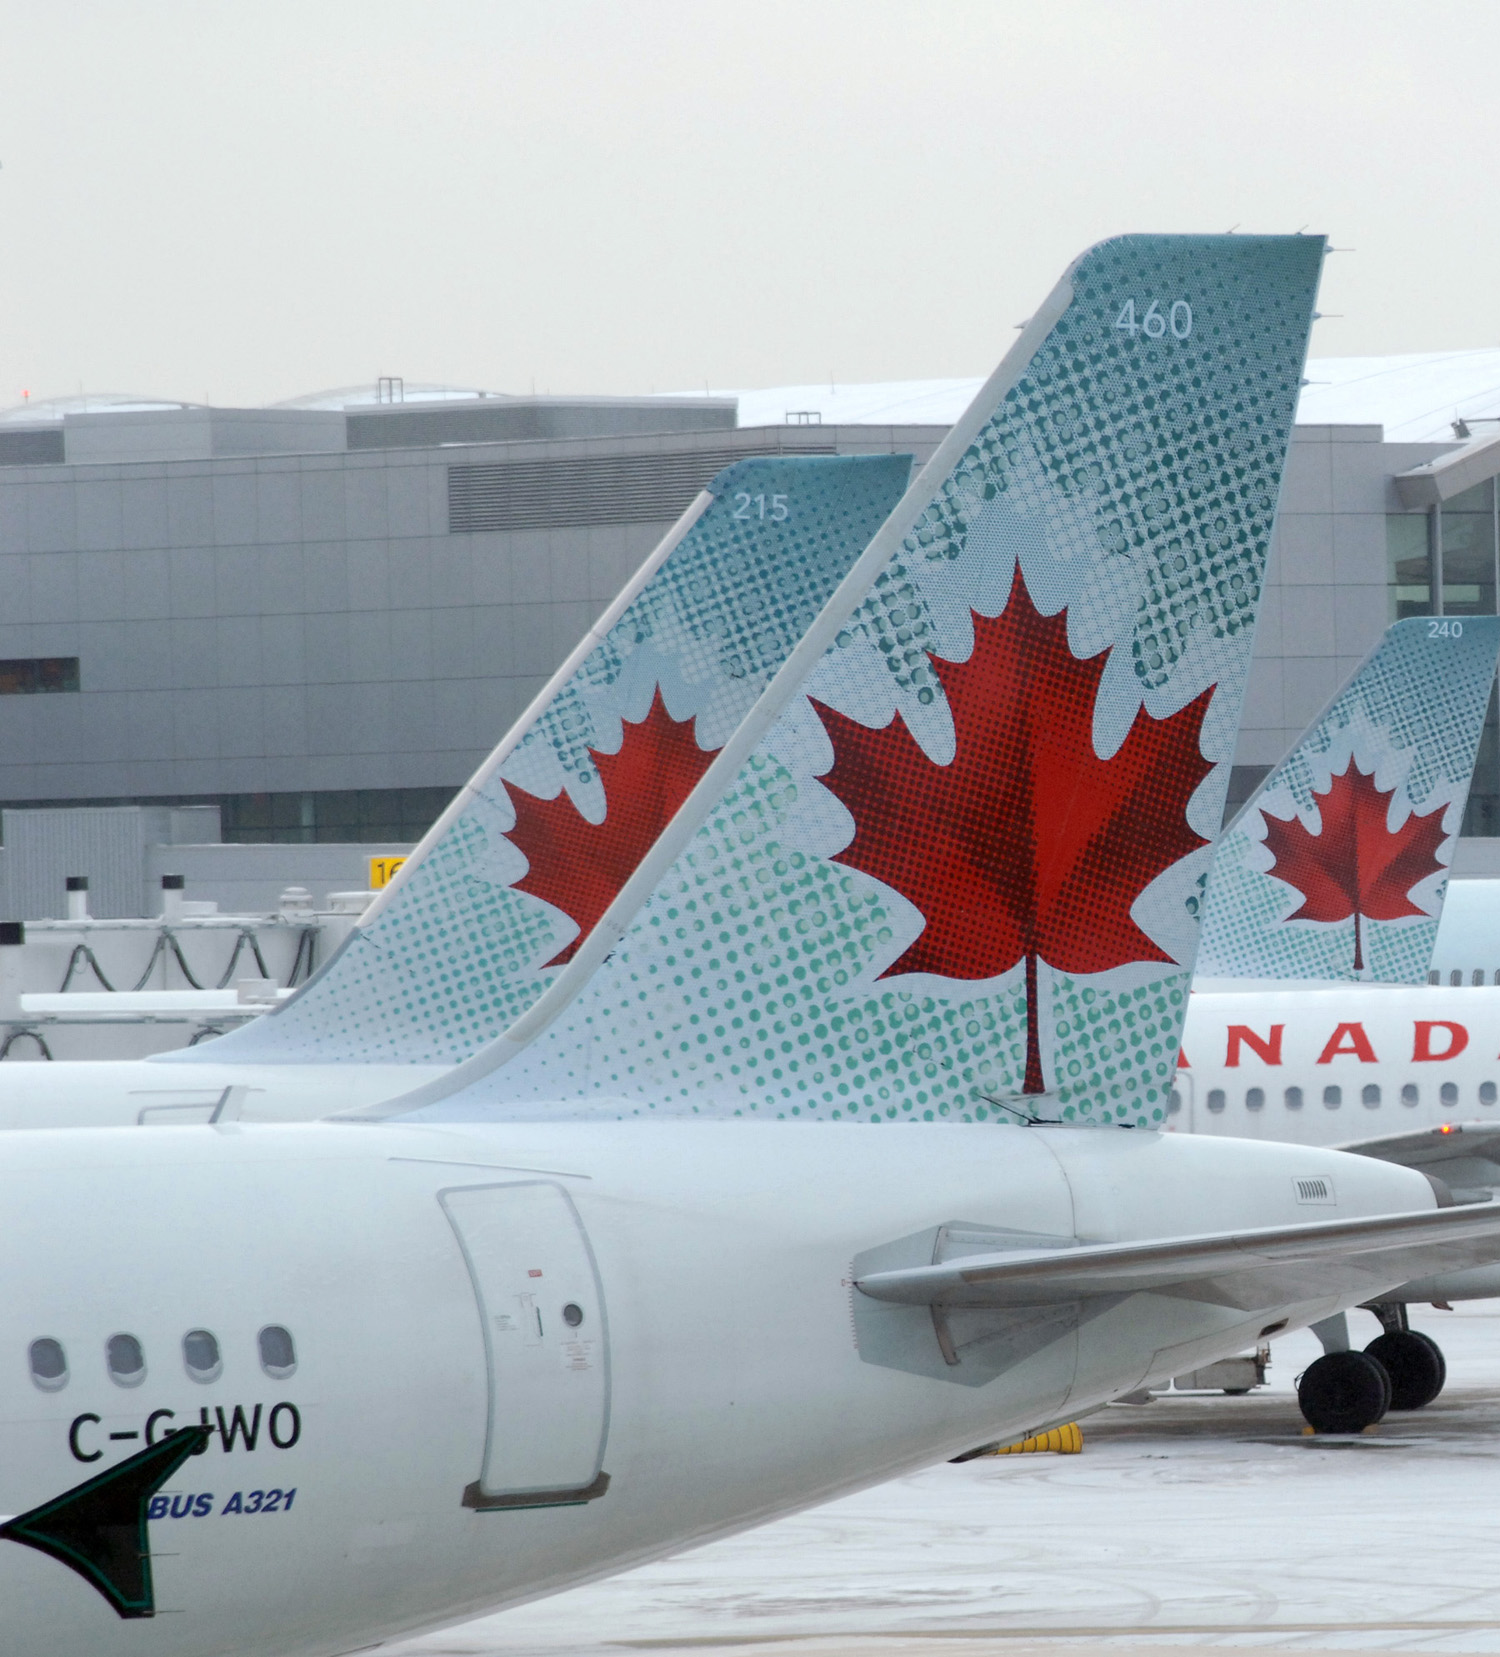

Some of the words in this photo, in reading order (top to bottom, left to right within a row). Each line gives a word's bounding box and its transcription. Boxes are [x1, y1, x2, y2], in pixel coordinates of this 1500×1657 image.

[1115, 299, 1192, 339] 460
[733, 492, 788, 521] 215
[1428, 621, 1463, 638] 240
[221, 1487, 298, 1516] A321
